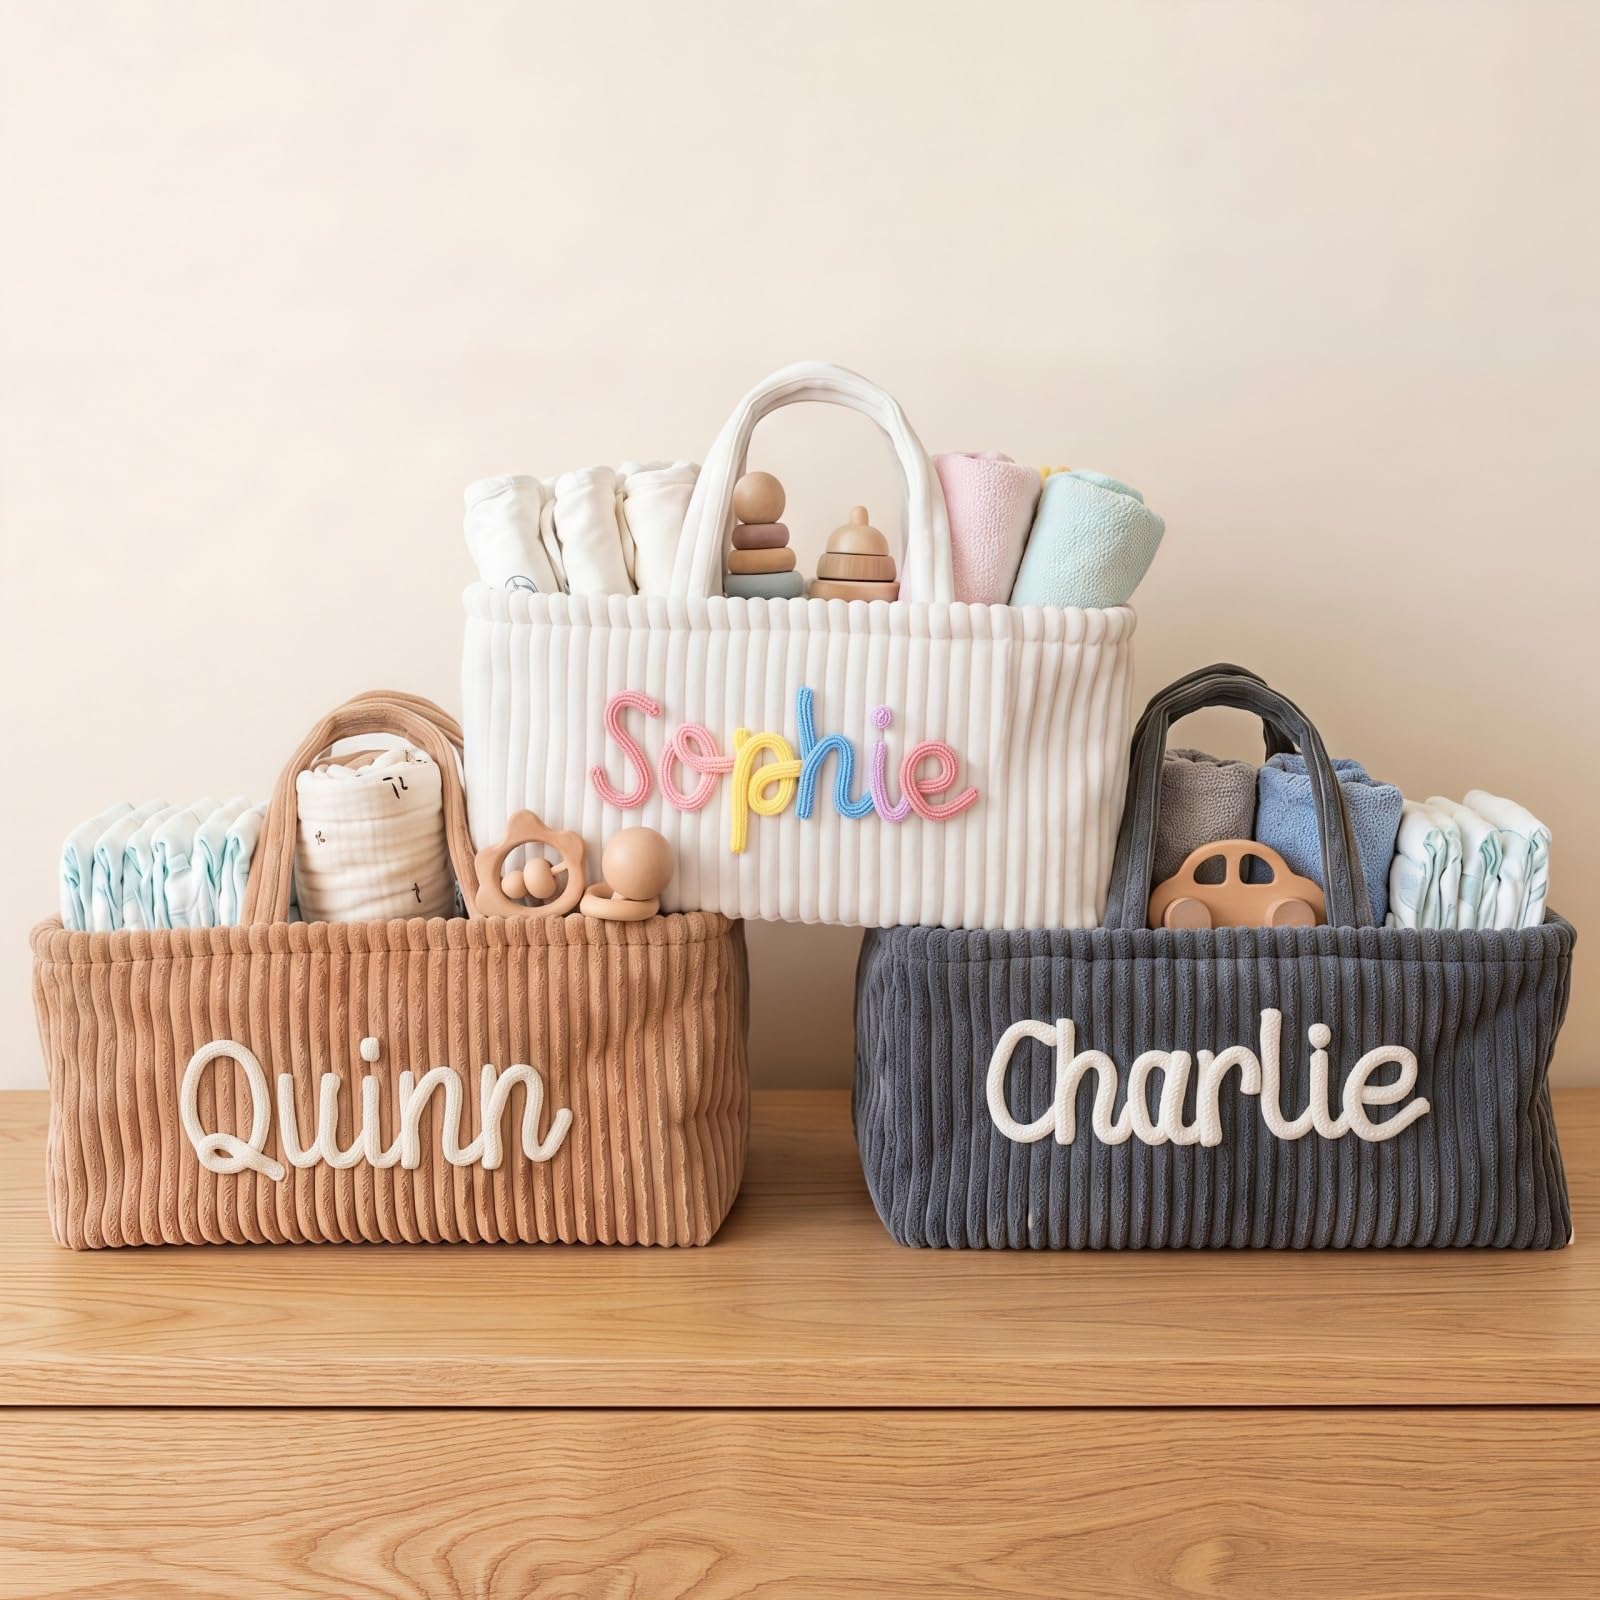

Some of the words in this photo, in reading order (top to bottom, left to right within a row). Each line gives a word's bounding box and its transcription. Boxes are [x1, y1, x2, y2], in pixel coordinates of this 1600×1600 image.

[590, 686, 980, 855] Sophie
[180, 1037, 573, 1182] Quinn
[986, 1007, 1431, 1147] Charlie
